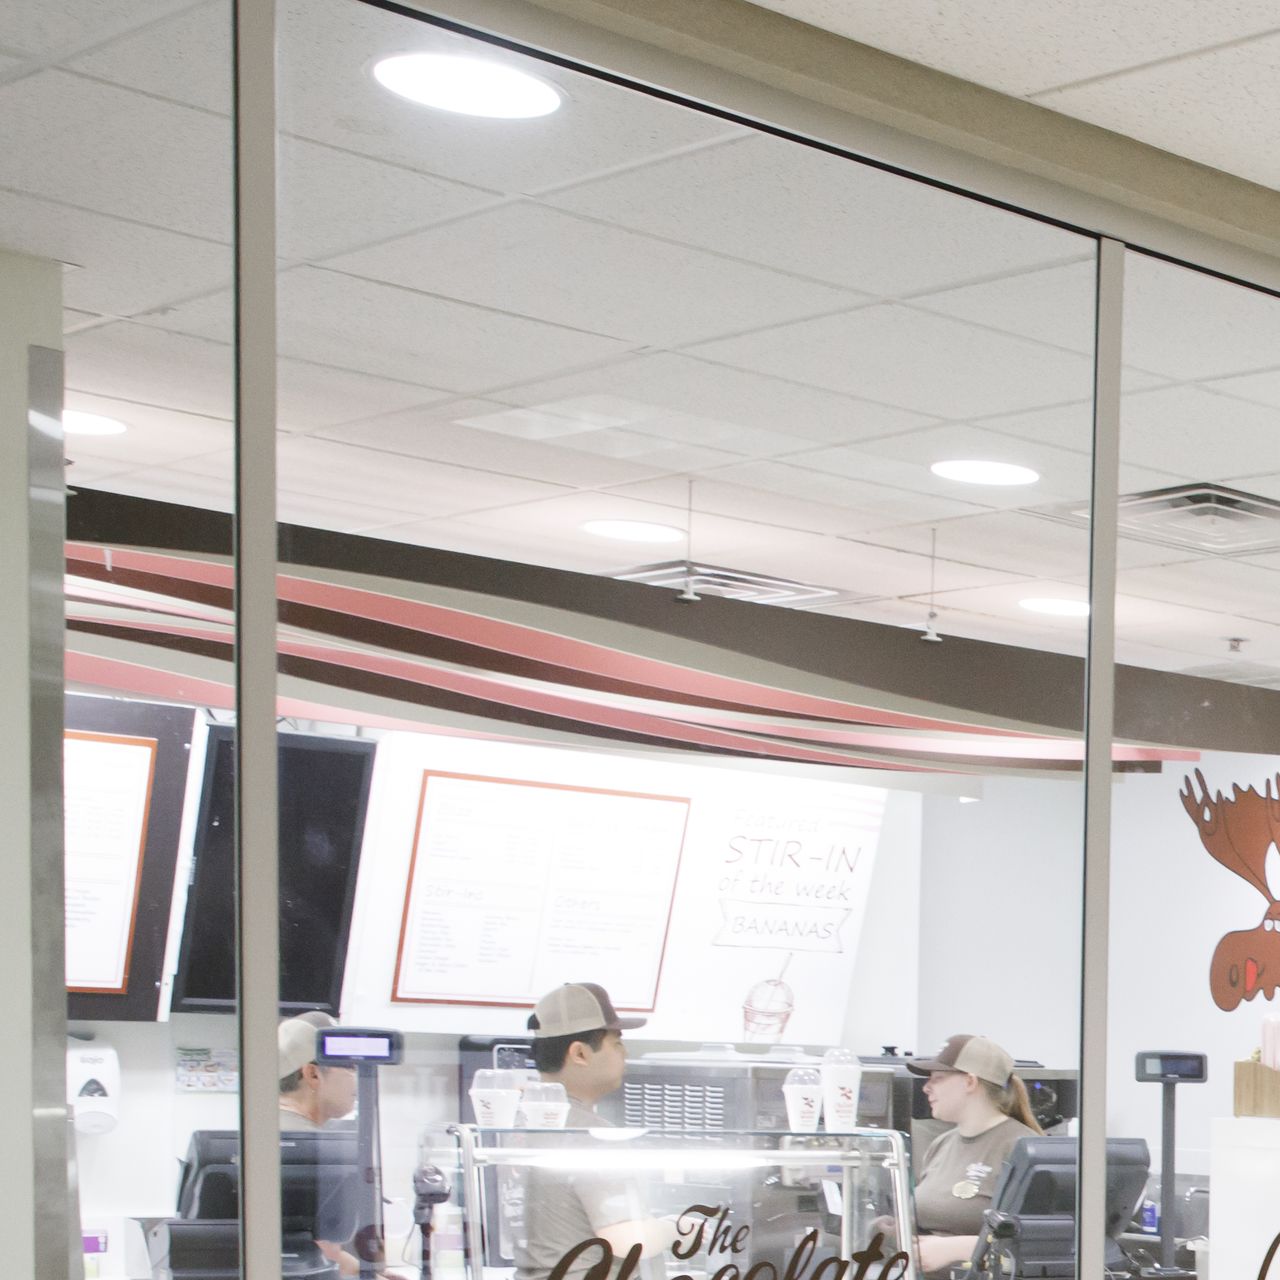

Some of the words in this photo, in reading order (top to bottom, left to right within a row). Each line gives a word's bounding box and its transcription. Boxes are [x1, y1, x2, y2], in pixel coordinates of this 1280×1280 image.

[717, 870, 745, 892] of
[749, 876, 785, 896] the
[794, 879, 853, 902] week
[732, 916, 835, 940] BANANAS
[672, 1205, 750, 1259] The
